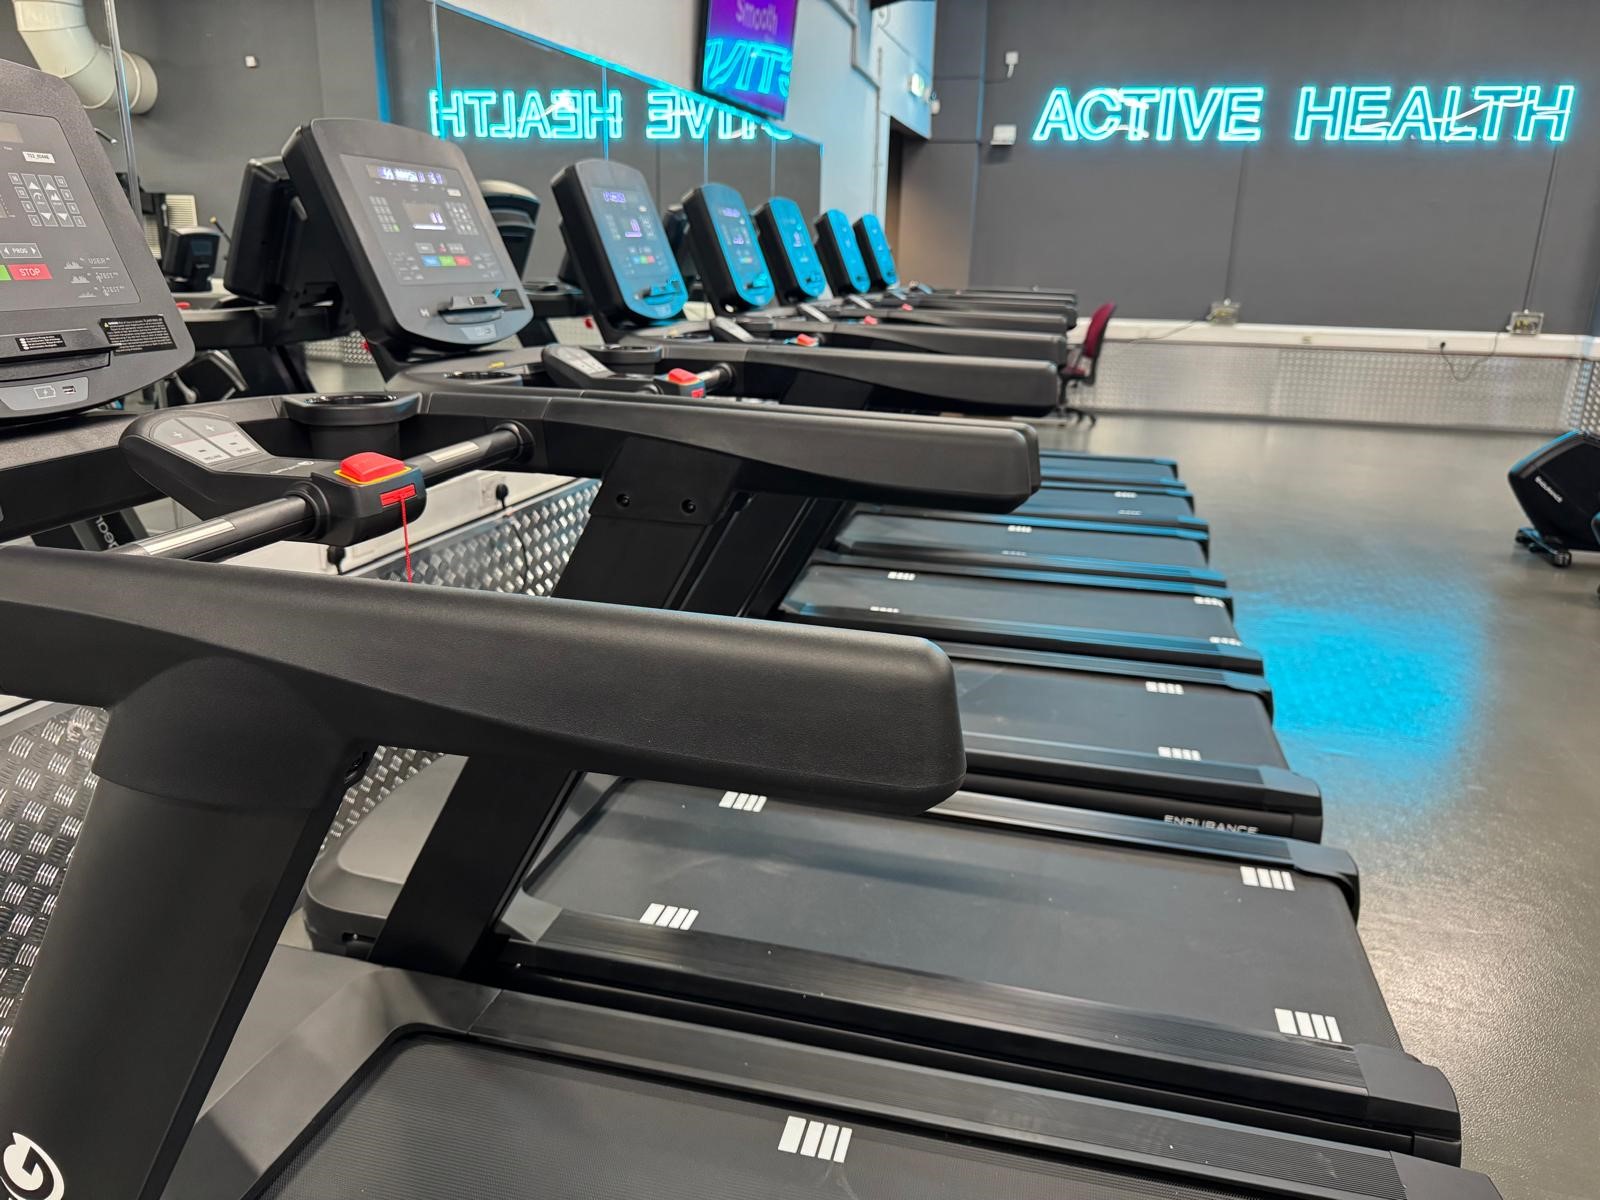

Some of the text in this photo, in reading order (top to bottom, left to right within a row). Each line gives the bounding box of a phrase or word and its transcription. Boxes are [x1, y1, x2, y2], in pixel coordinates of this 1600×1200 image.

[1032, 85, 1575, 141] ACTIVE HEALTH
[19, 268, 41, 277] STOP
